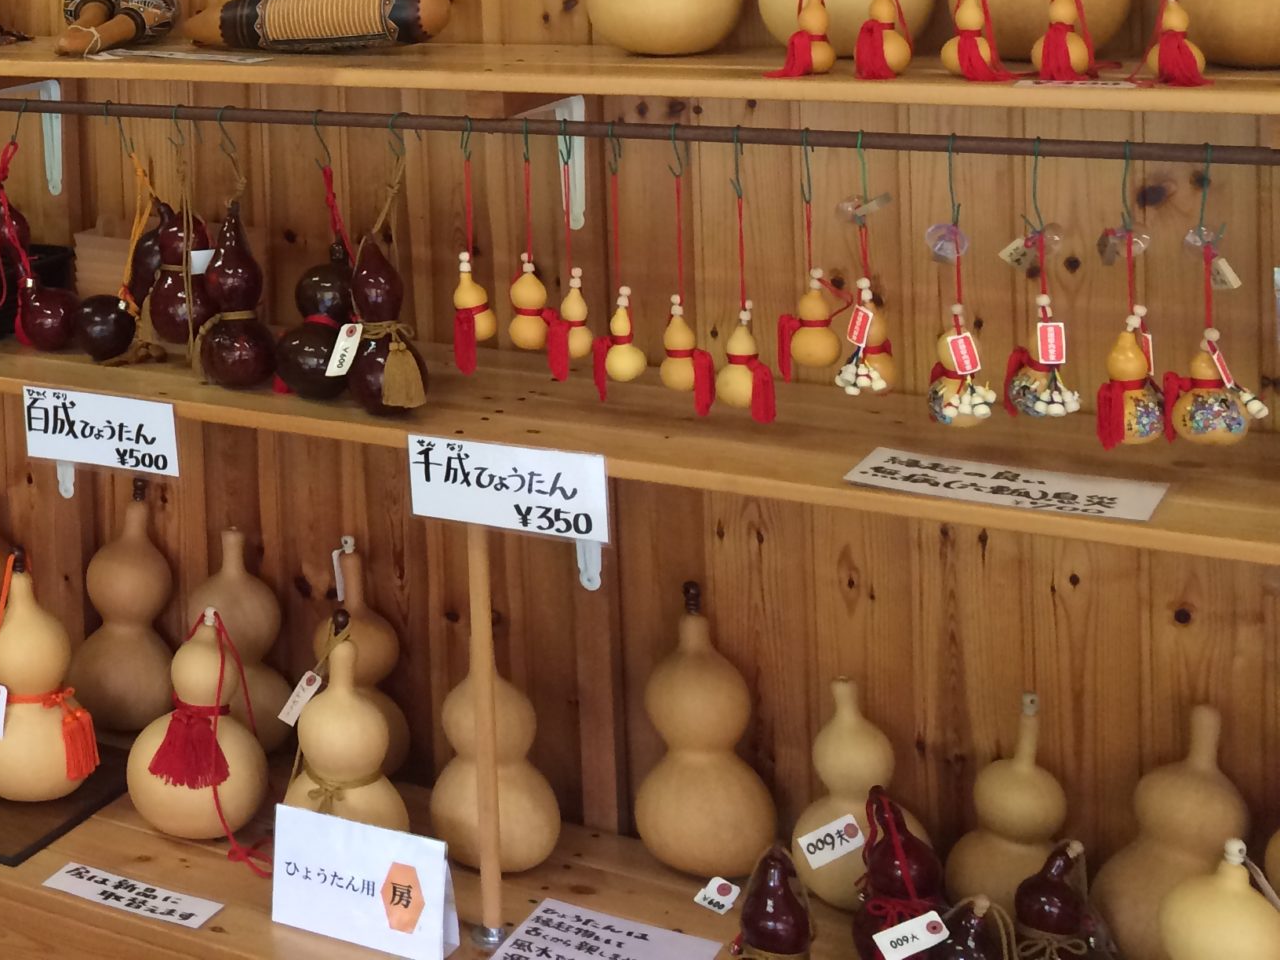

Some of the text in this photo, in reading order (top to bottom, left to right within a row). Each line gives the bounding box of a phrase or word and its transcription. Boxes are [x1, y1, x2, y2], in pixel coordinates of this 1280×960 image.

[26, 397, 157, 446] 百成ひょうたん
[115, 447, 168, 471] ¥500
[412, 446, 578, 501] 千成ひょうたん
[513, 503, 593, 535] ¥350
[284, 860, 413, 909] ひょうたん用 房
[889, 933, 920, 950] ¥600
